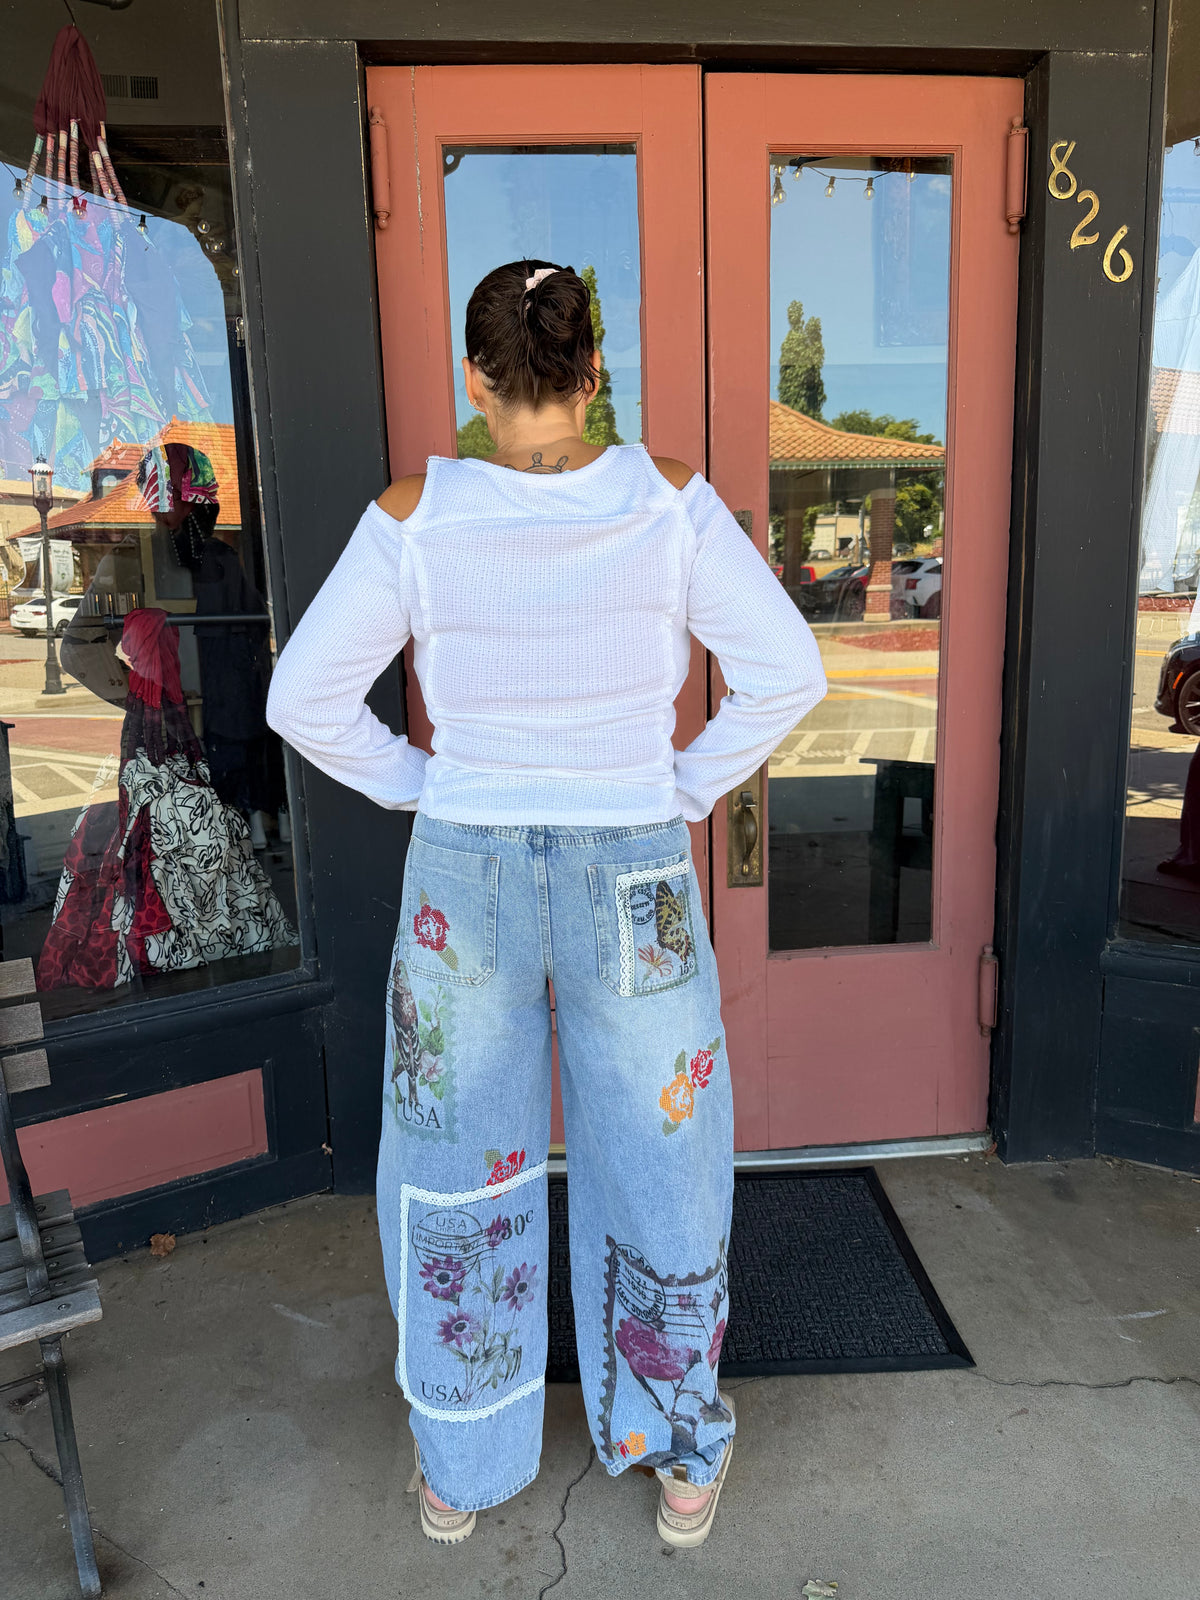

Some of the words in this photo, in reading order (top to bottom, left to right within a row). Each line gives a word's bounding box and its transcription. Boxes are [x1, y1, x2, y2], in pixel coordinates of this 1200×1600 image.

[1048, 140, 1134, 283] 826
[402, 1095, 442, 1129] USA
[435, 1216, 467, 1229] USA
[420, 1379, 462, 1402] USA
